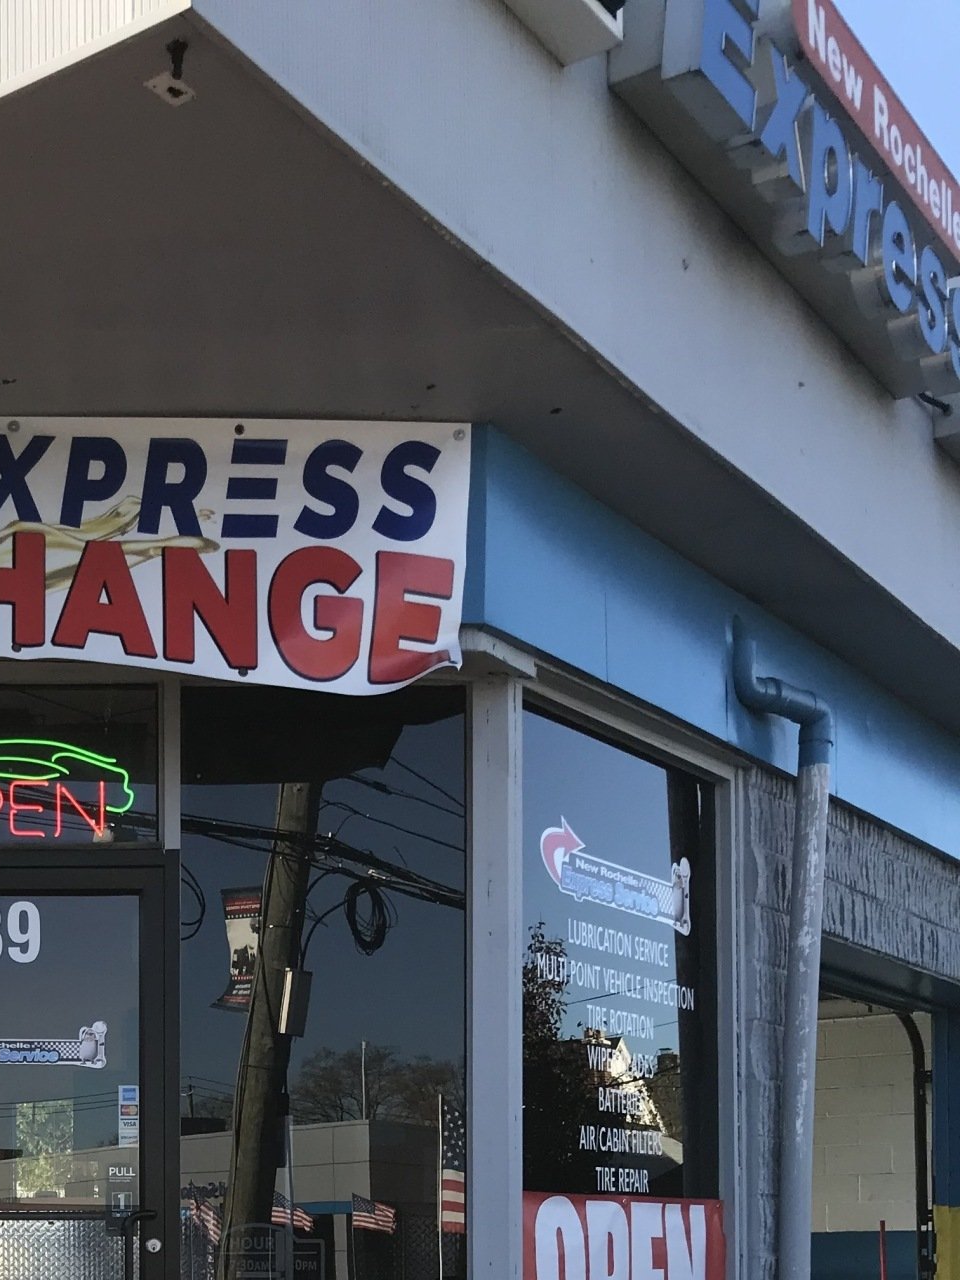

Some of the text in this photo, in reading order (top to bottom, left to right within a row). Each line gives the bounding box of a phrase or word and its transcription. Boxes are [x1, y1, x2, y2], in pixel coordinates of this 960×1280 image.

[807, 0, 863, 111] New
[701, 0, 960, 380] Expres
[561, 864, 613, 901] Express
[575, 858, 640, 887] New Rochelle
[568, 918, 669, 967] LUBRICATION SERVICE
[570, 960, 600, 990] POINT
[603, 967, 641, 999] VEHICLE
[643, 977, 695, 1011] INSPECTION
[587, 1004, 655, 1040] TIRE ROTATION
[579, 1125, 663, 1156] AIR/CABIN FILTERS
[108, 1167, 136, 1176] PULL
[595, 1166, 650, 1193] TIRE REPAIR
[117, 1193, 125, 1209] 1
